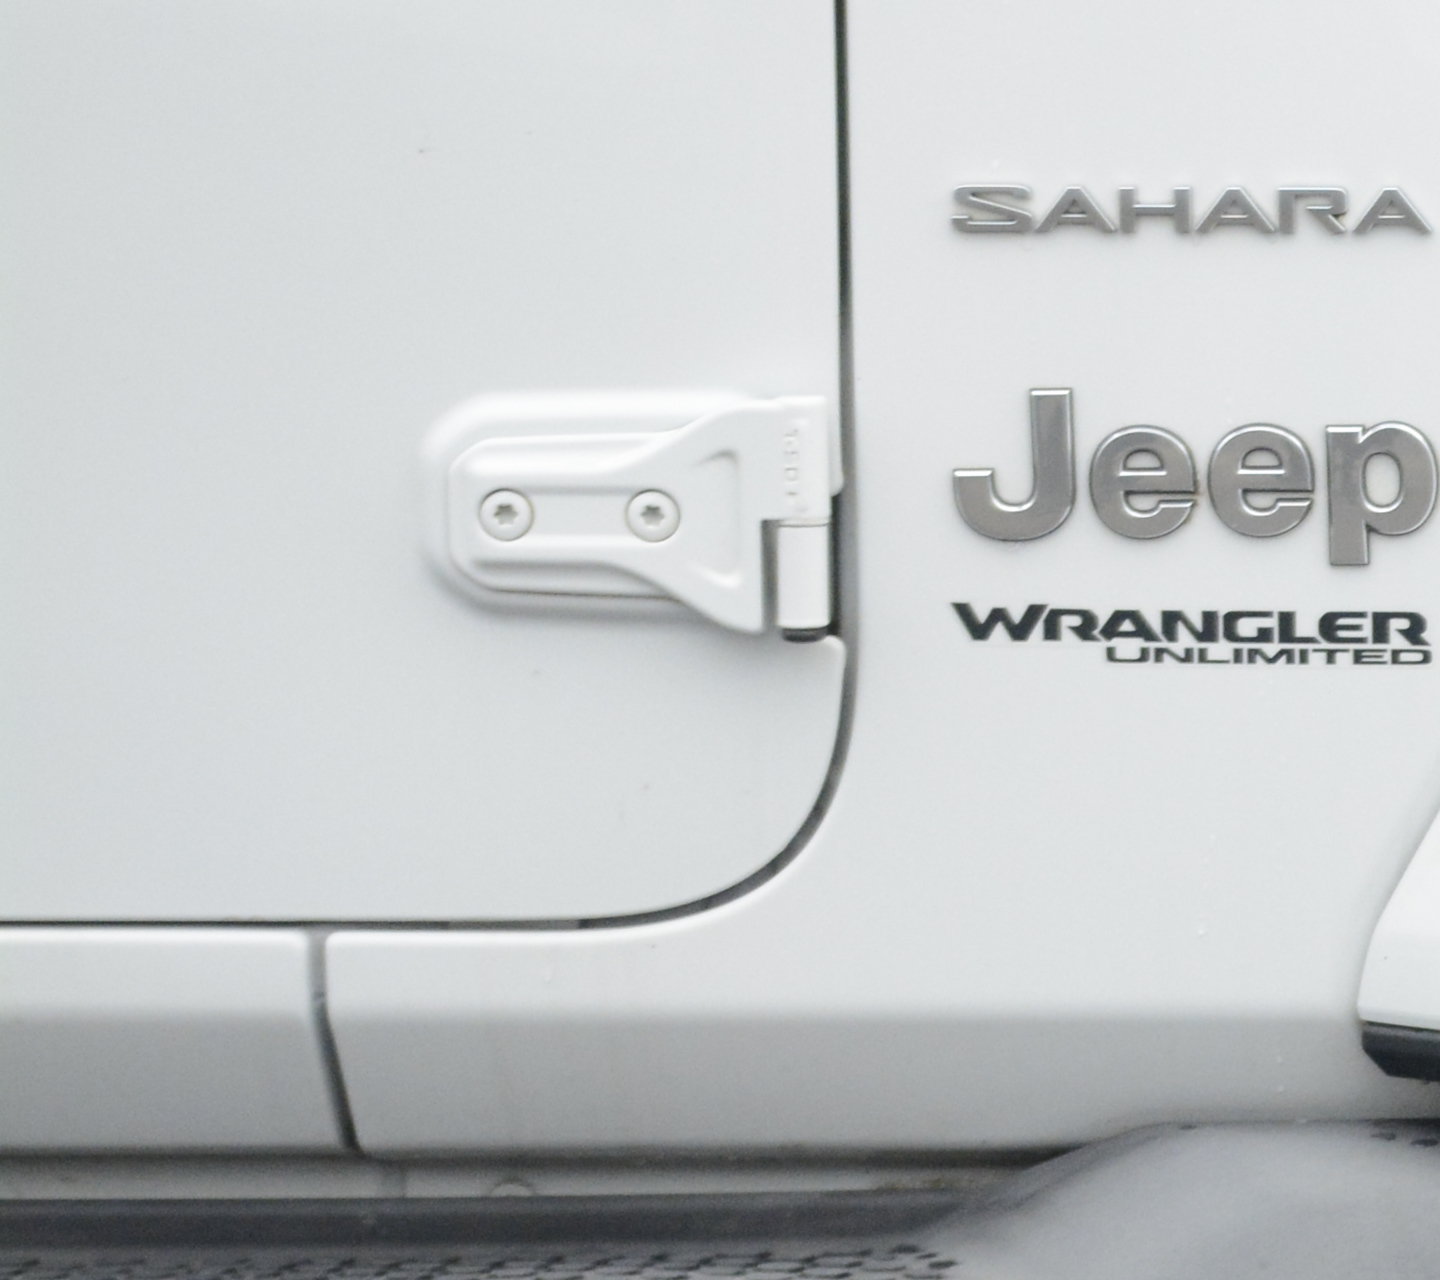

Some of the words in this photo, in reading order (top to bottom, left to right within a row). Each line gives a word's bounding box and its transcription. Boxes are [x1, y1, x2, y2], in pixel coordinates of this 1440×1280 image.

[950, 184, 1434, 235] SAHARA
[951, 386, 1440, 567] Jeep
[950, 601, 1432, 647] WRANGLER
[1105, 645, 1434, 666] UNLIMITED
